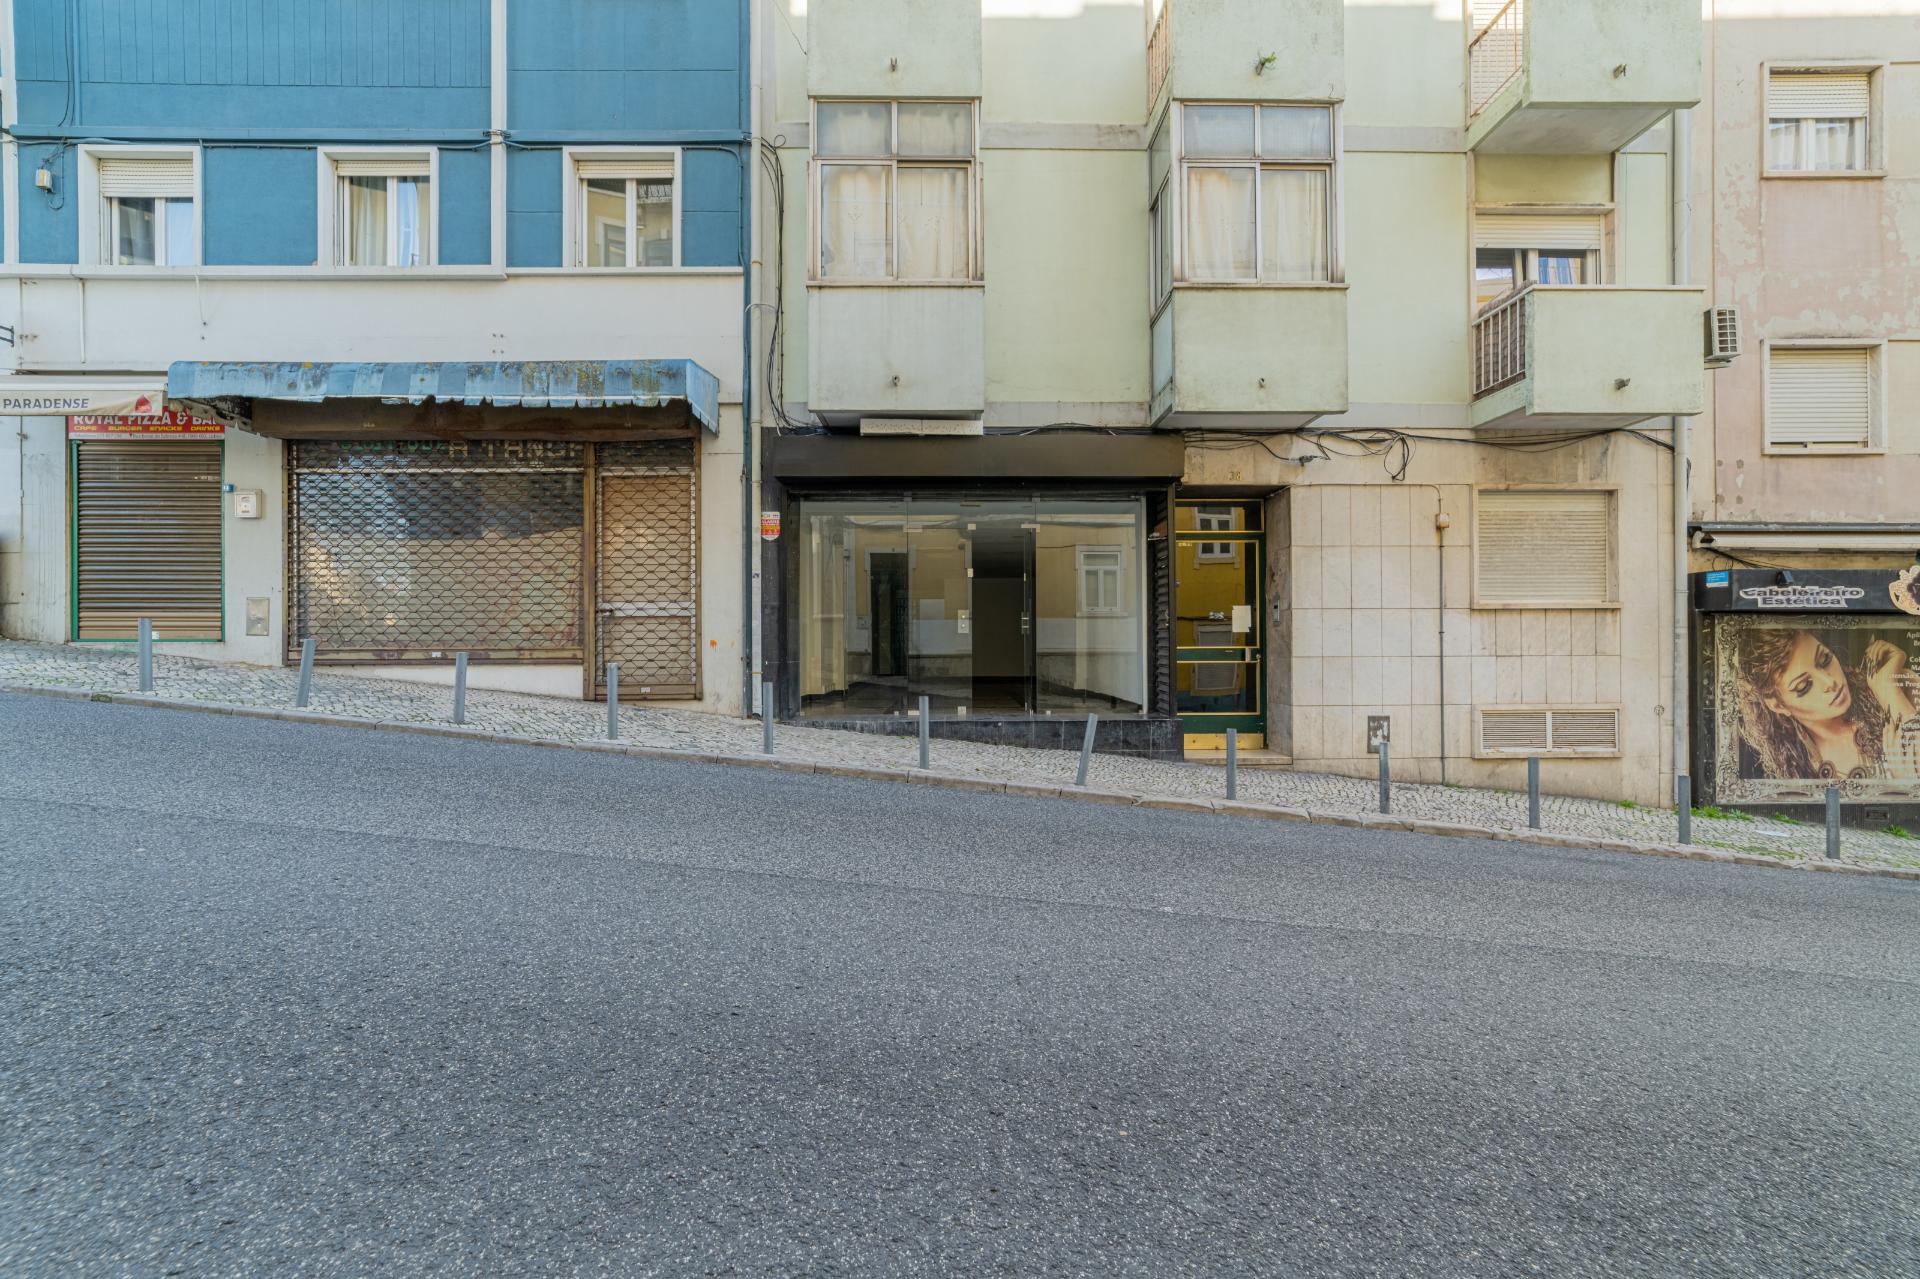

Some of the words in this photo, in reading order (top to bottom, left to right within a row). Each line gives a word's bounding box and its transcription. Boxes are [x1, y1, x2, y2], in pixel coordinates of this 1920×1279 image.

[3, 398, 89, 409] PARADENSE
[74, 415, 123, 424] ROYAL
[128, 412, 171, 424] PIZZA
[1743, 588, 1860, 597] Cabeleireiro
[1762, 597, 1840, 605] Estética
